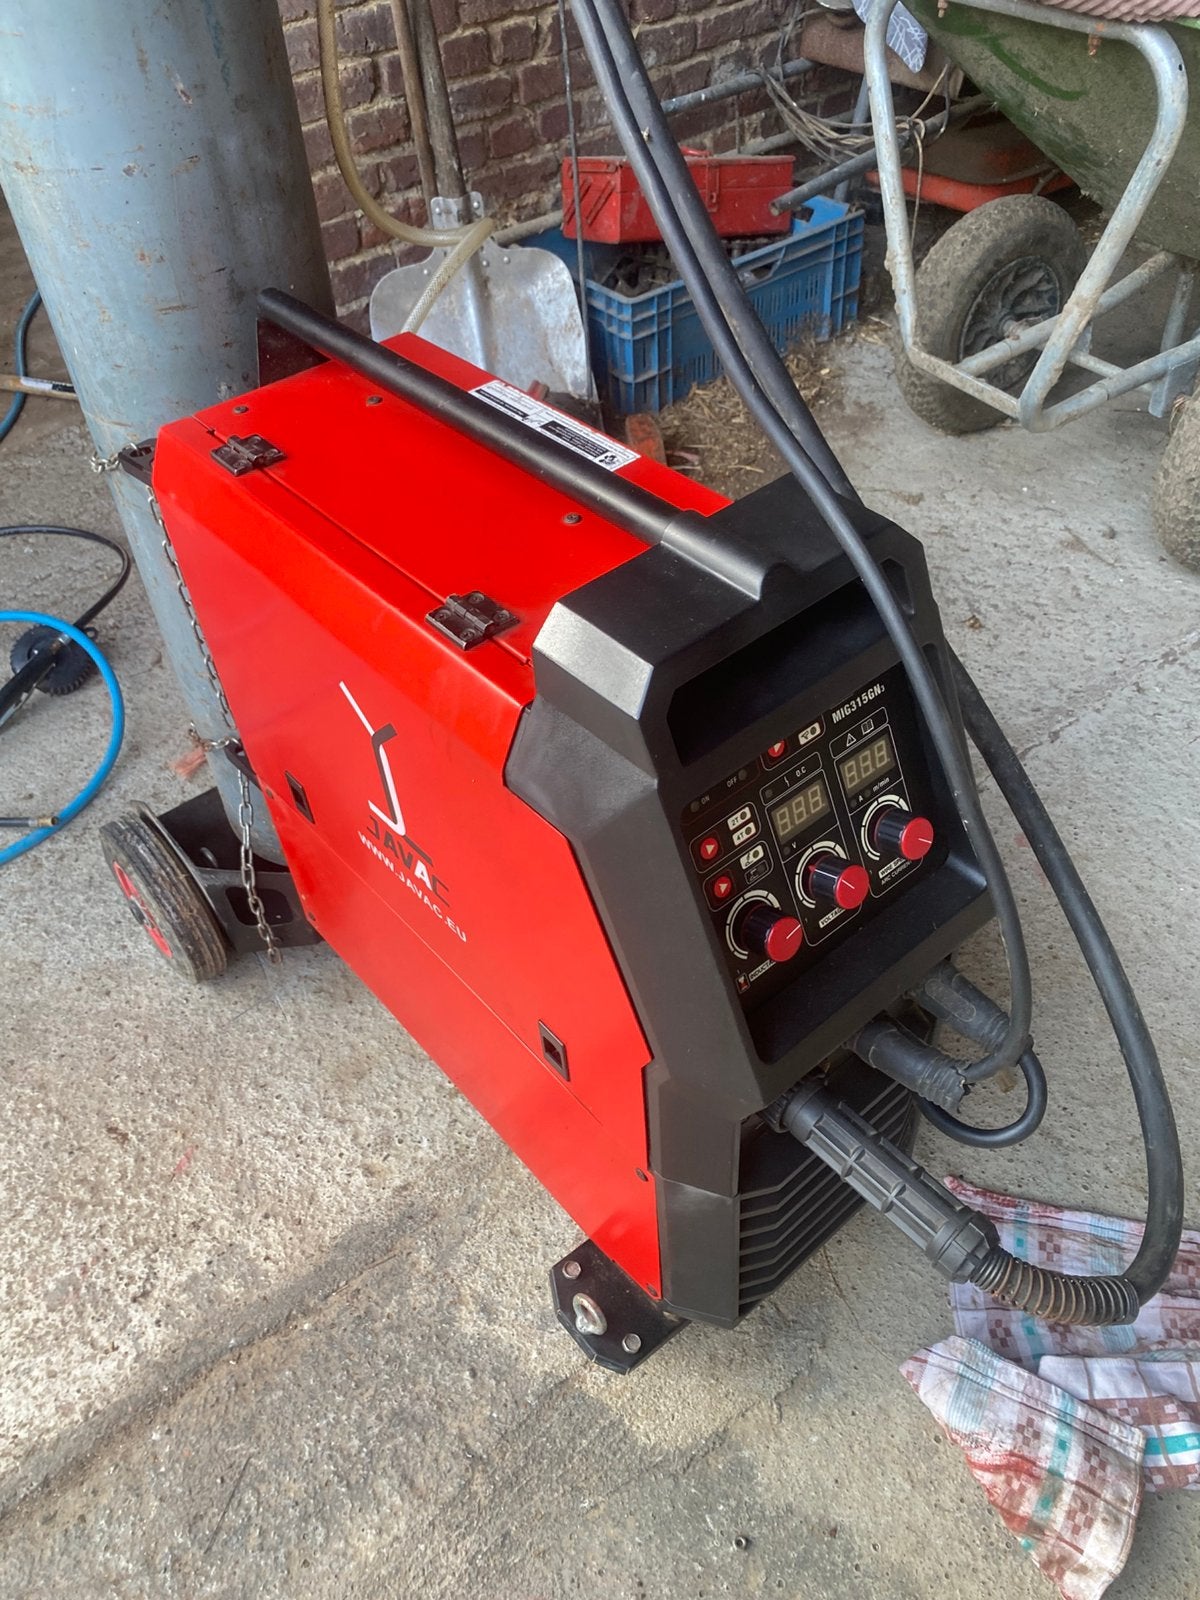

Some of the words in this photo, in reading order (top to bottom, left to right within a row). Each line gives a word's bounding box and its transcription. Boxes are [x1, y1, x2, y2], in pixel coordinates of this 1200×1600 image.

[726, 776, 738, 788] OFF
[872, 777, 890, 792] m/min
[701, 795, 710, 805] ON
[730, 816, 739, 827] 2T
[736, 831, 744, 841] 4T
[366, 815, 450, 908] JAVAC
[357, 830, 468, 943] WWW.JAVAC.EU
